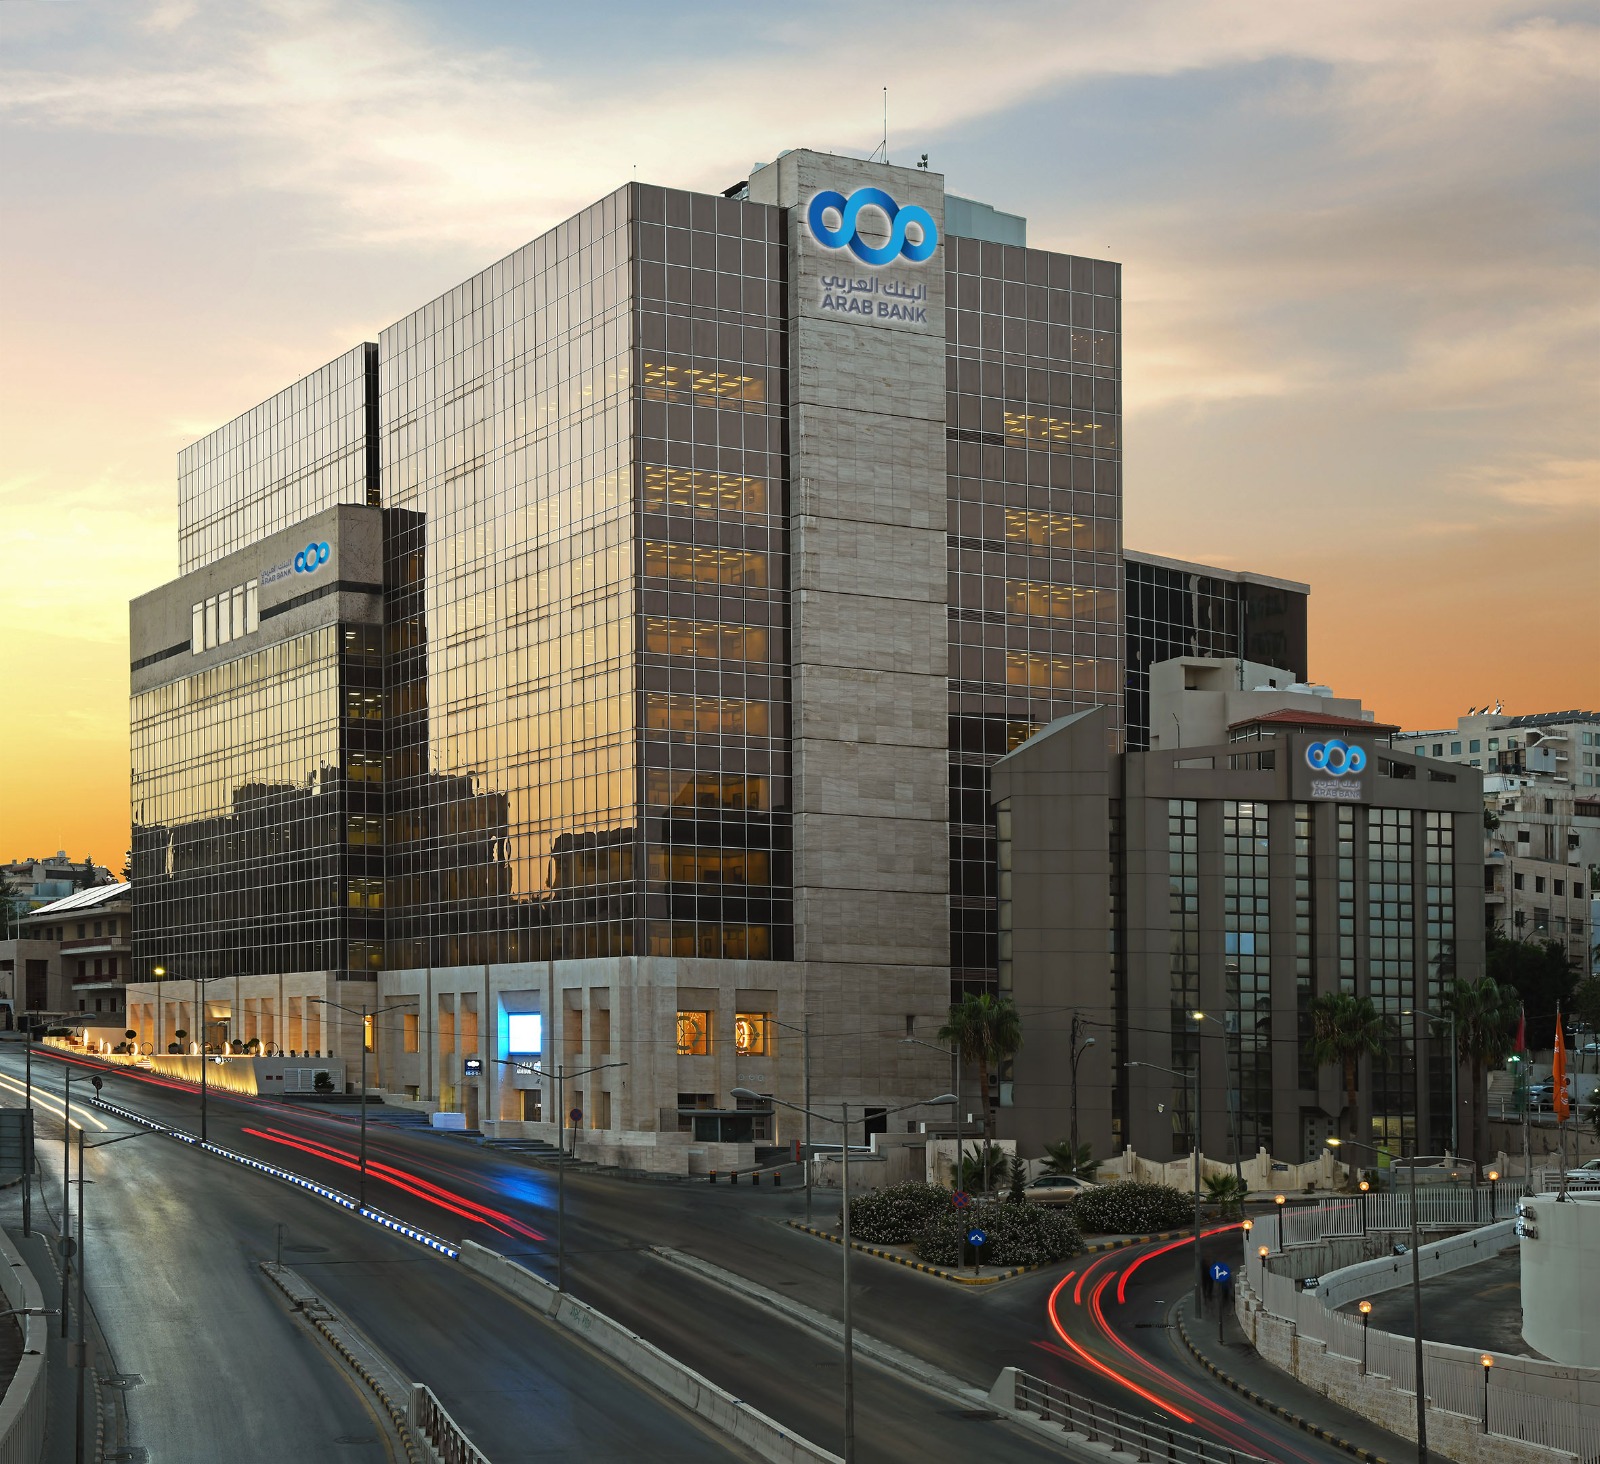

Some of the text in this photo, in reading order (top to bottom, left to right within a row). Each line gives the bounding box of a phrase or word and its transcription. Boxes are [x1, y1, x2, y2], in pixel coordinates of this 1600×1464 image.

[821, 275, 927, 303] البنك العربي
[821, 294, 927, 323] ARAB BANK
[260, 567, 292, 586] ARAB BANK
[1313, 788, 1361, 799] ARAB BANK
